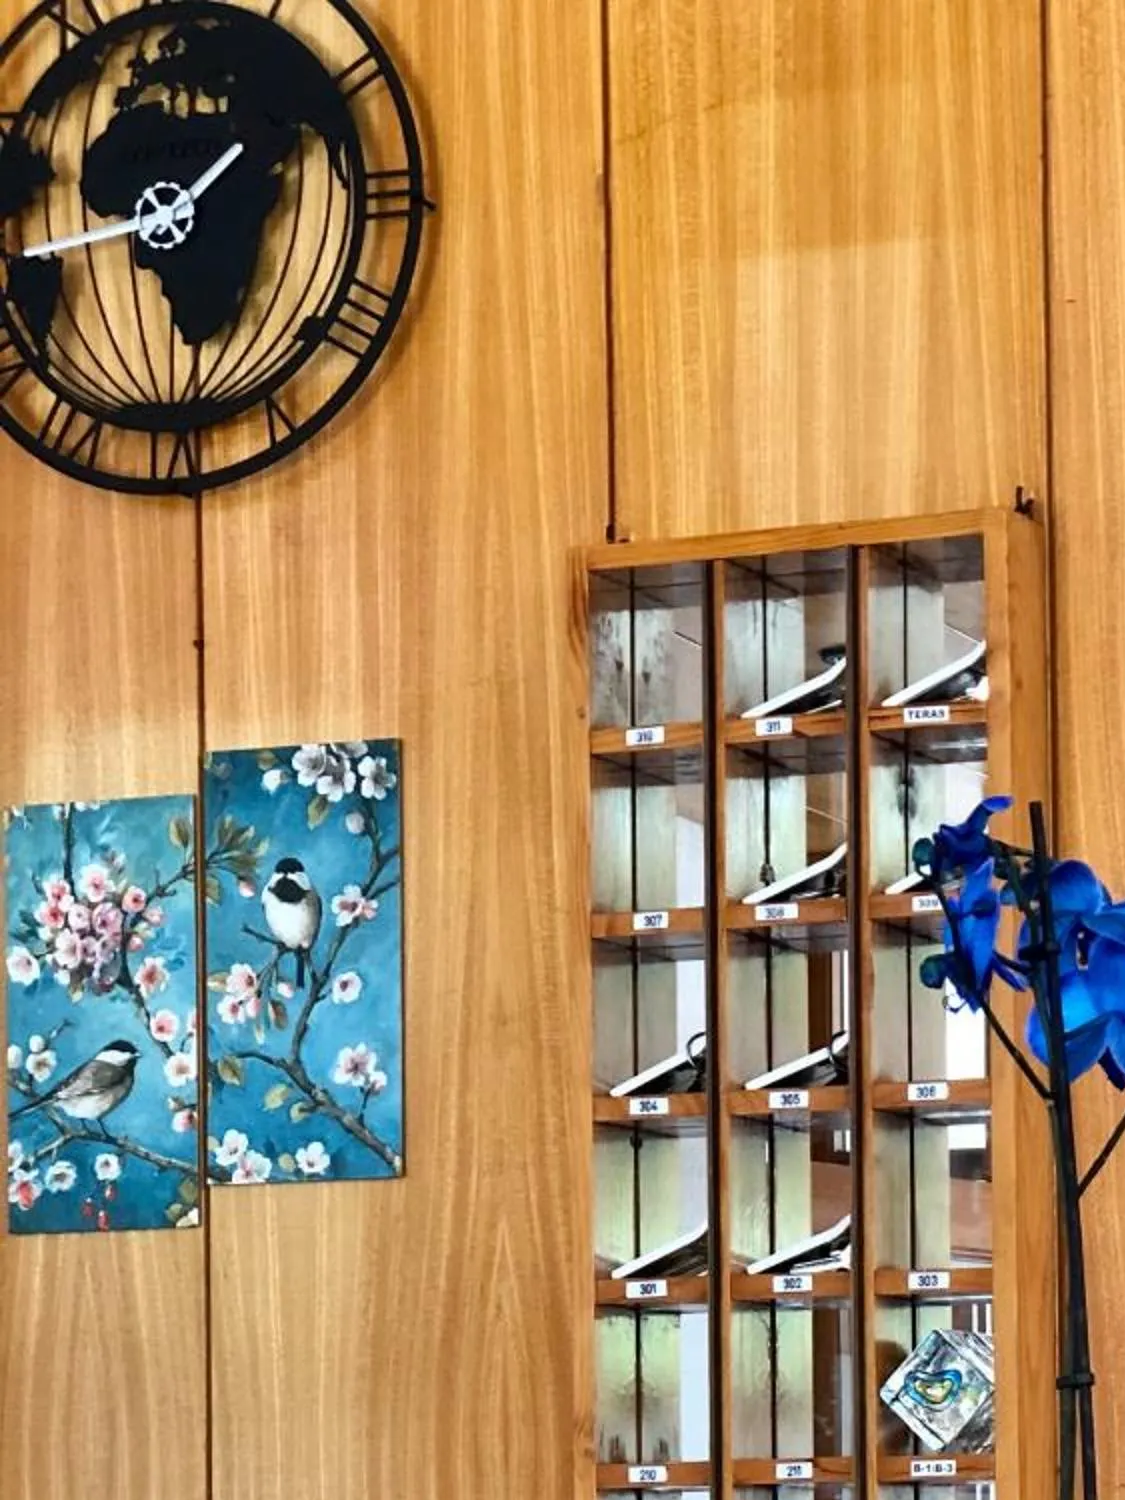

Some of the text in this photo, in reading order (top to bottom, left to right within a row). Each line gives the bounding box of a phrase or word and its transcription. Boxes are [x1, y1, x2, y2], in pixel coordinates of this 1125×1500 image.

[639, 1101, 658, 1113] 304
[783, 1277, 802, 1290] 302
[917, 1275, 938, 1287] 303
[639, 1283, 657, 1295] 301
[639, 1469, 657, 1481] 210
